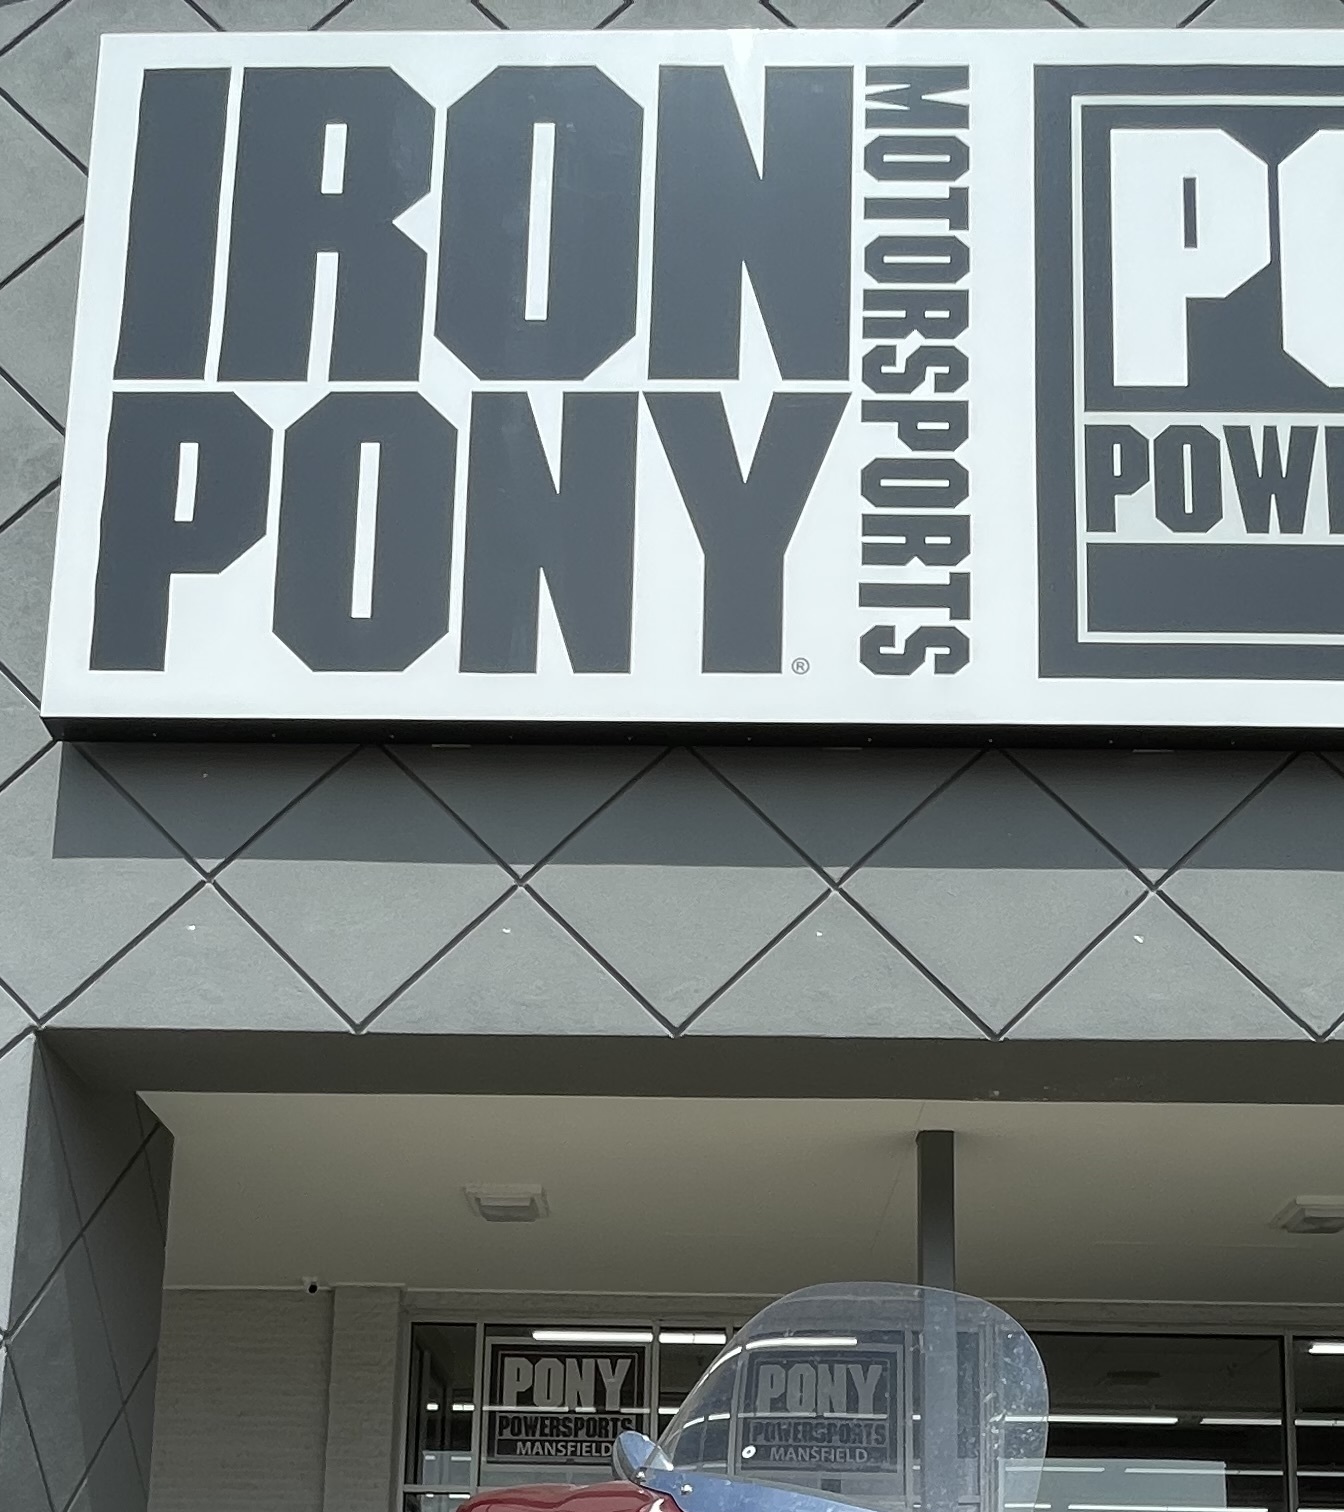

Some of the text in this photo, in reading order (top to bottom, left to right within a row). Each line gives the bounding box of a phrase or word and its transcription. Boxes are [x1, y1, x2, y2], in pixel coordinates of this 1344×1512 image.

[113, 64, 853, 382] IRON
[859, 64, 970, 676] MOTORSPORTS
[89, 391, 852, 674] PONY
[503, 1357, 632, 1411] PONY
[757, 1363, 883, 1415] PONY
[516, 1441, 613, 1457] MANSFIELD
[752, 1421, 887, 1445] POWERSPORTS
[769, 1447, 868, 1463] MANSFIELD
